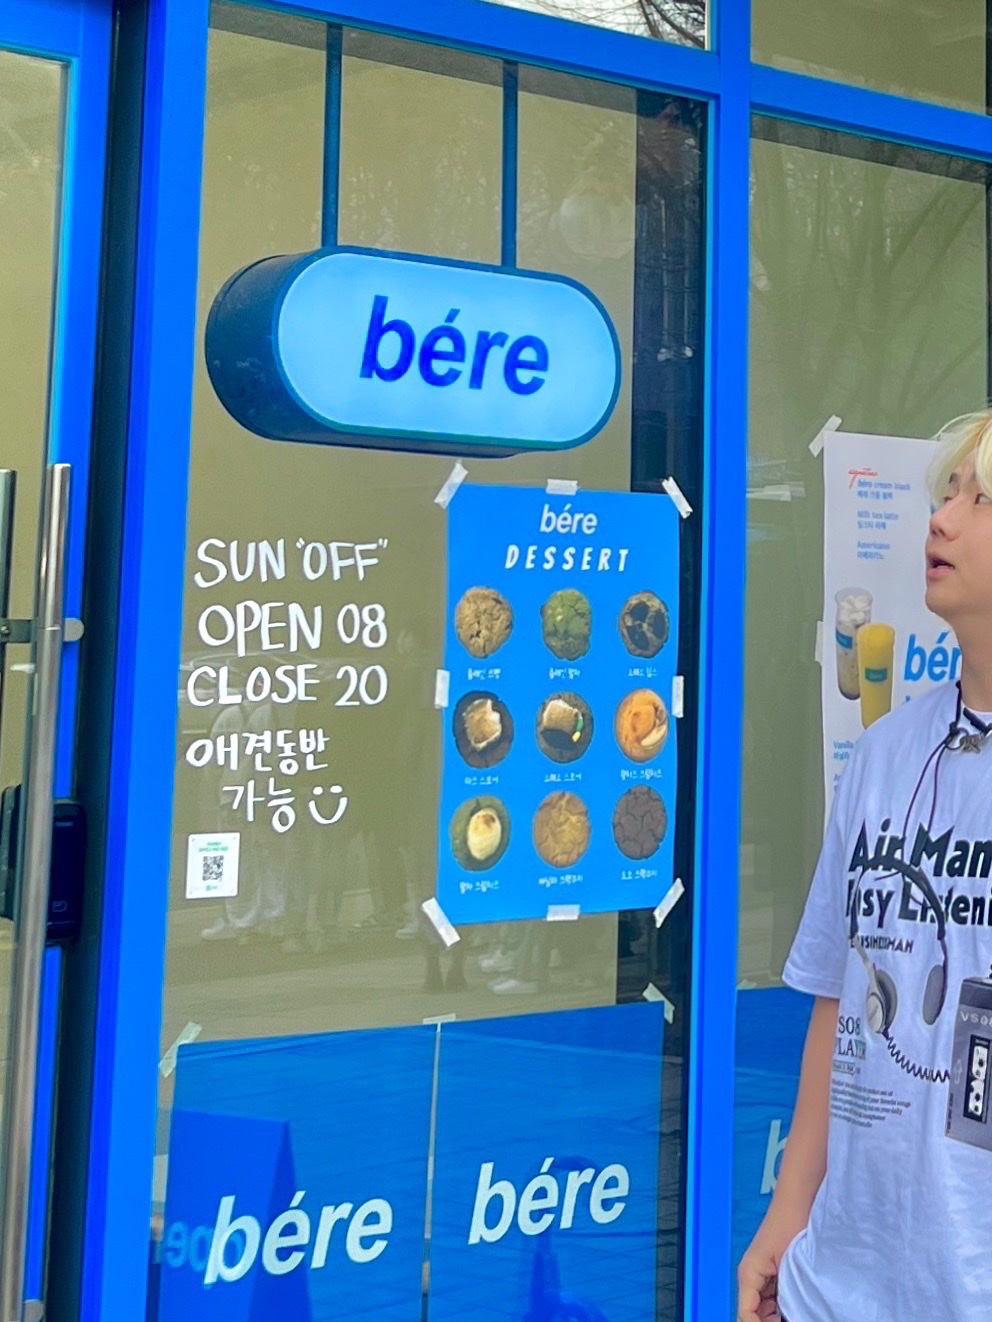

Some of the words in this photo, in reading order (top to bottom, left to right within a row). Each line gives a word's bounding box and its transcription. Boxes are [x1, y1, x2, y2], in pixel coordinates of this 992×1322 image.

[359, 294, 549, 396] bére
[539, 503, 598, 534] bére
[194, 538, 287, 588] SUN
[505, 544, 629, 572] DESSERT
[198, 600, 323, 658] OPEN
[336, 602, 388, 649] 08
[904, 630, 962, 682] bér
[187, 663, 320, 707] CLOSE
[334, 664, 388, 707] 20
[185, 728, 330, 775] 애견동반
[222, 777, 296, 833] 가능
[468, 1157, 629, 1245] bére
[204, 1190, 393, 1285] bére
